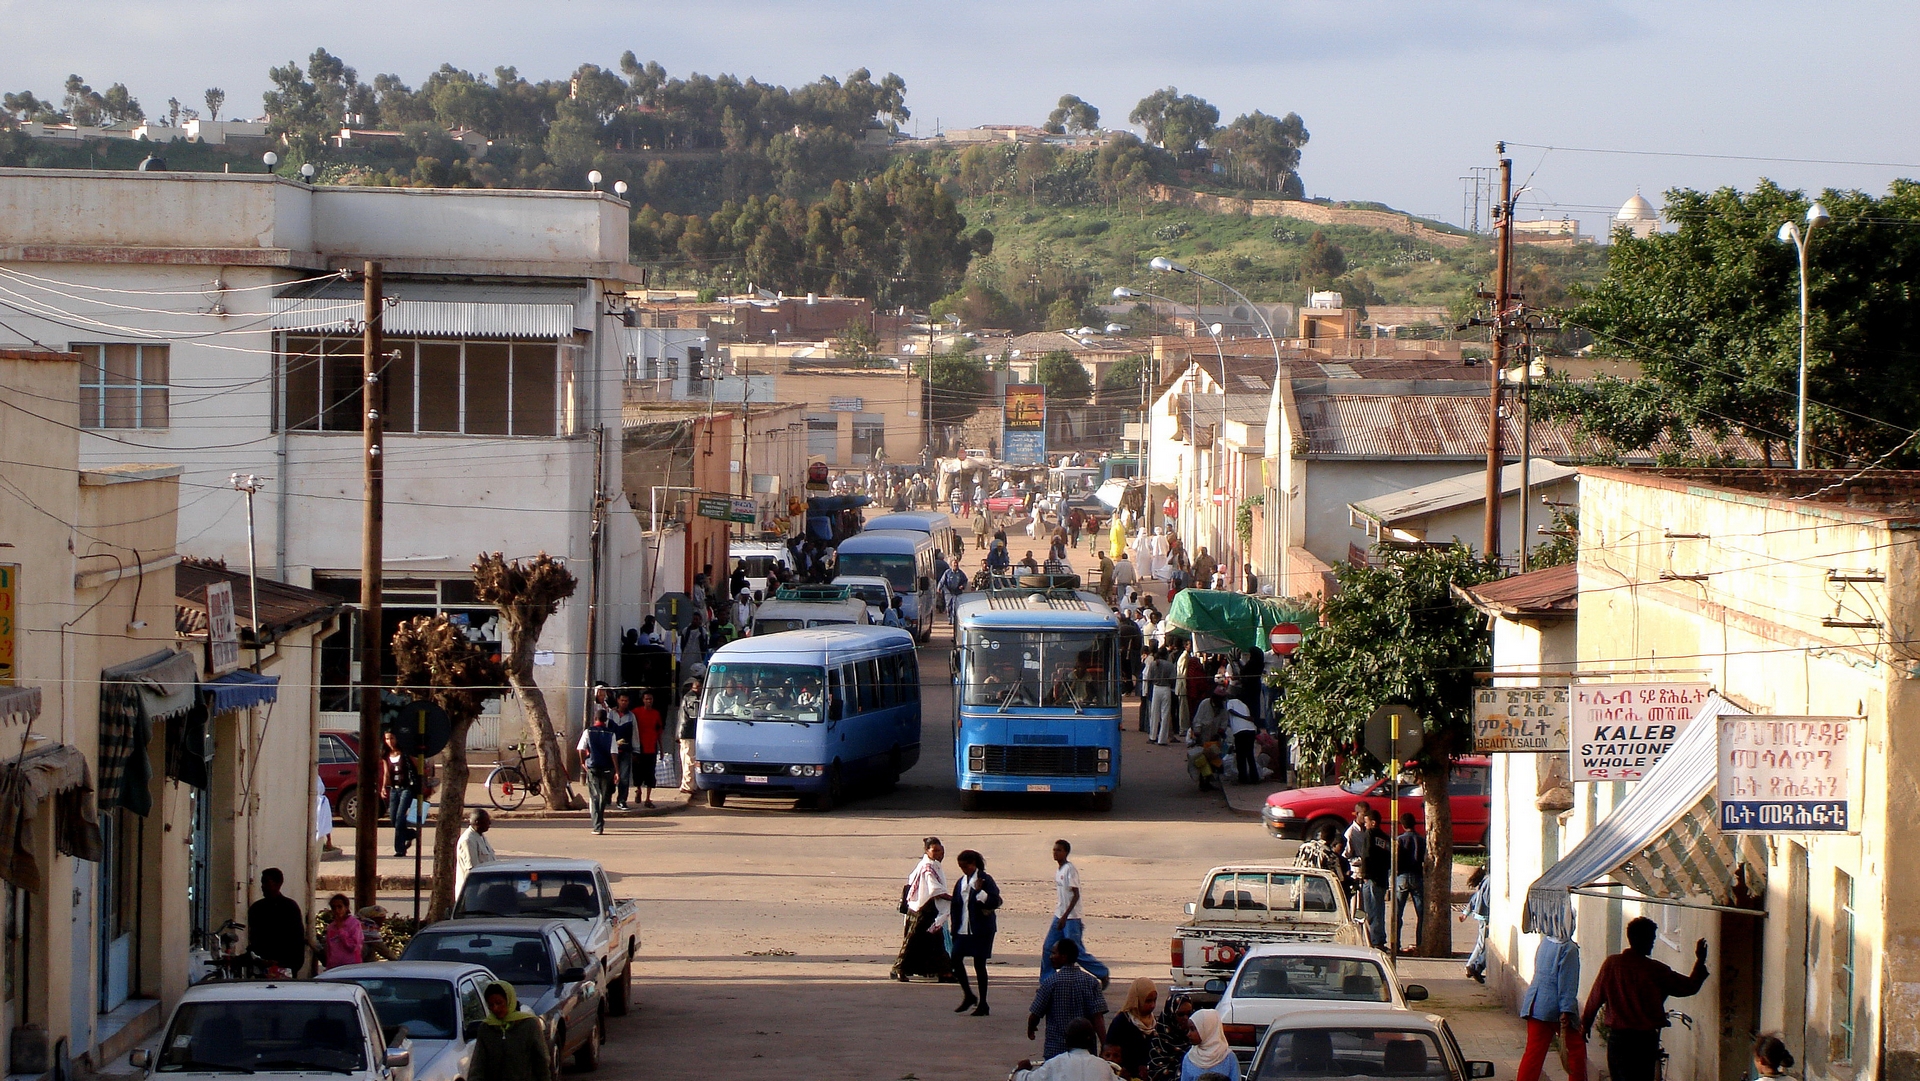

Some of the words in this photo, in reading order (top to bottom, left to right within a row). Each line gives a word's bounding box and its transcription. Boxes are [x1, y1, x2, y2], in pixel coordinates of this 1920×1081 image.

[1640, 689, 1656, 704] ናይ
[1594, 725, 1676, 740] KALEB
[1581, 743, 1674, 755] STATIONE
[1583, 757, 1646, 768] WHOLE
[1725, 804, 1755, 824] ቤት
